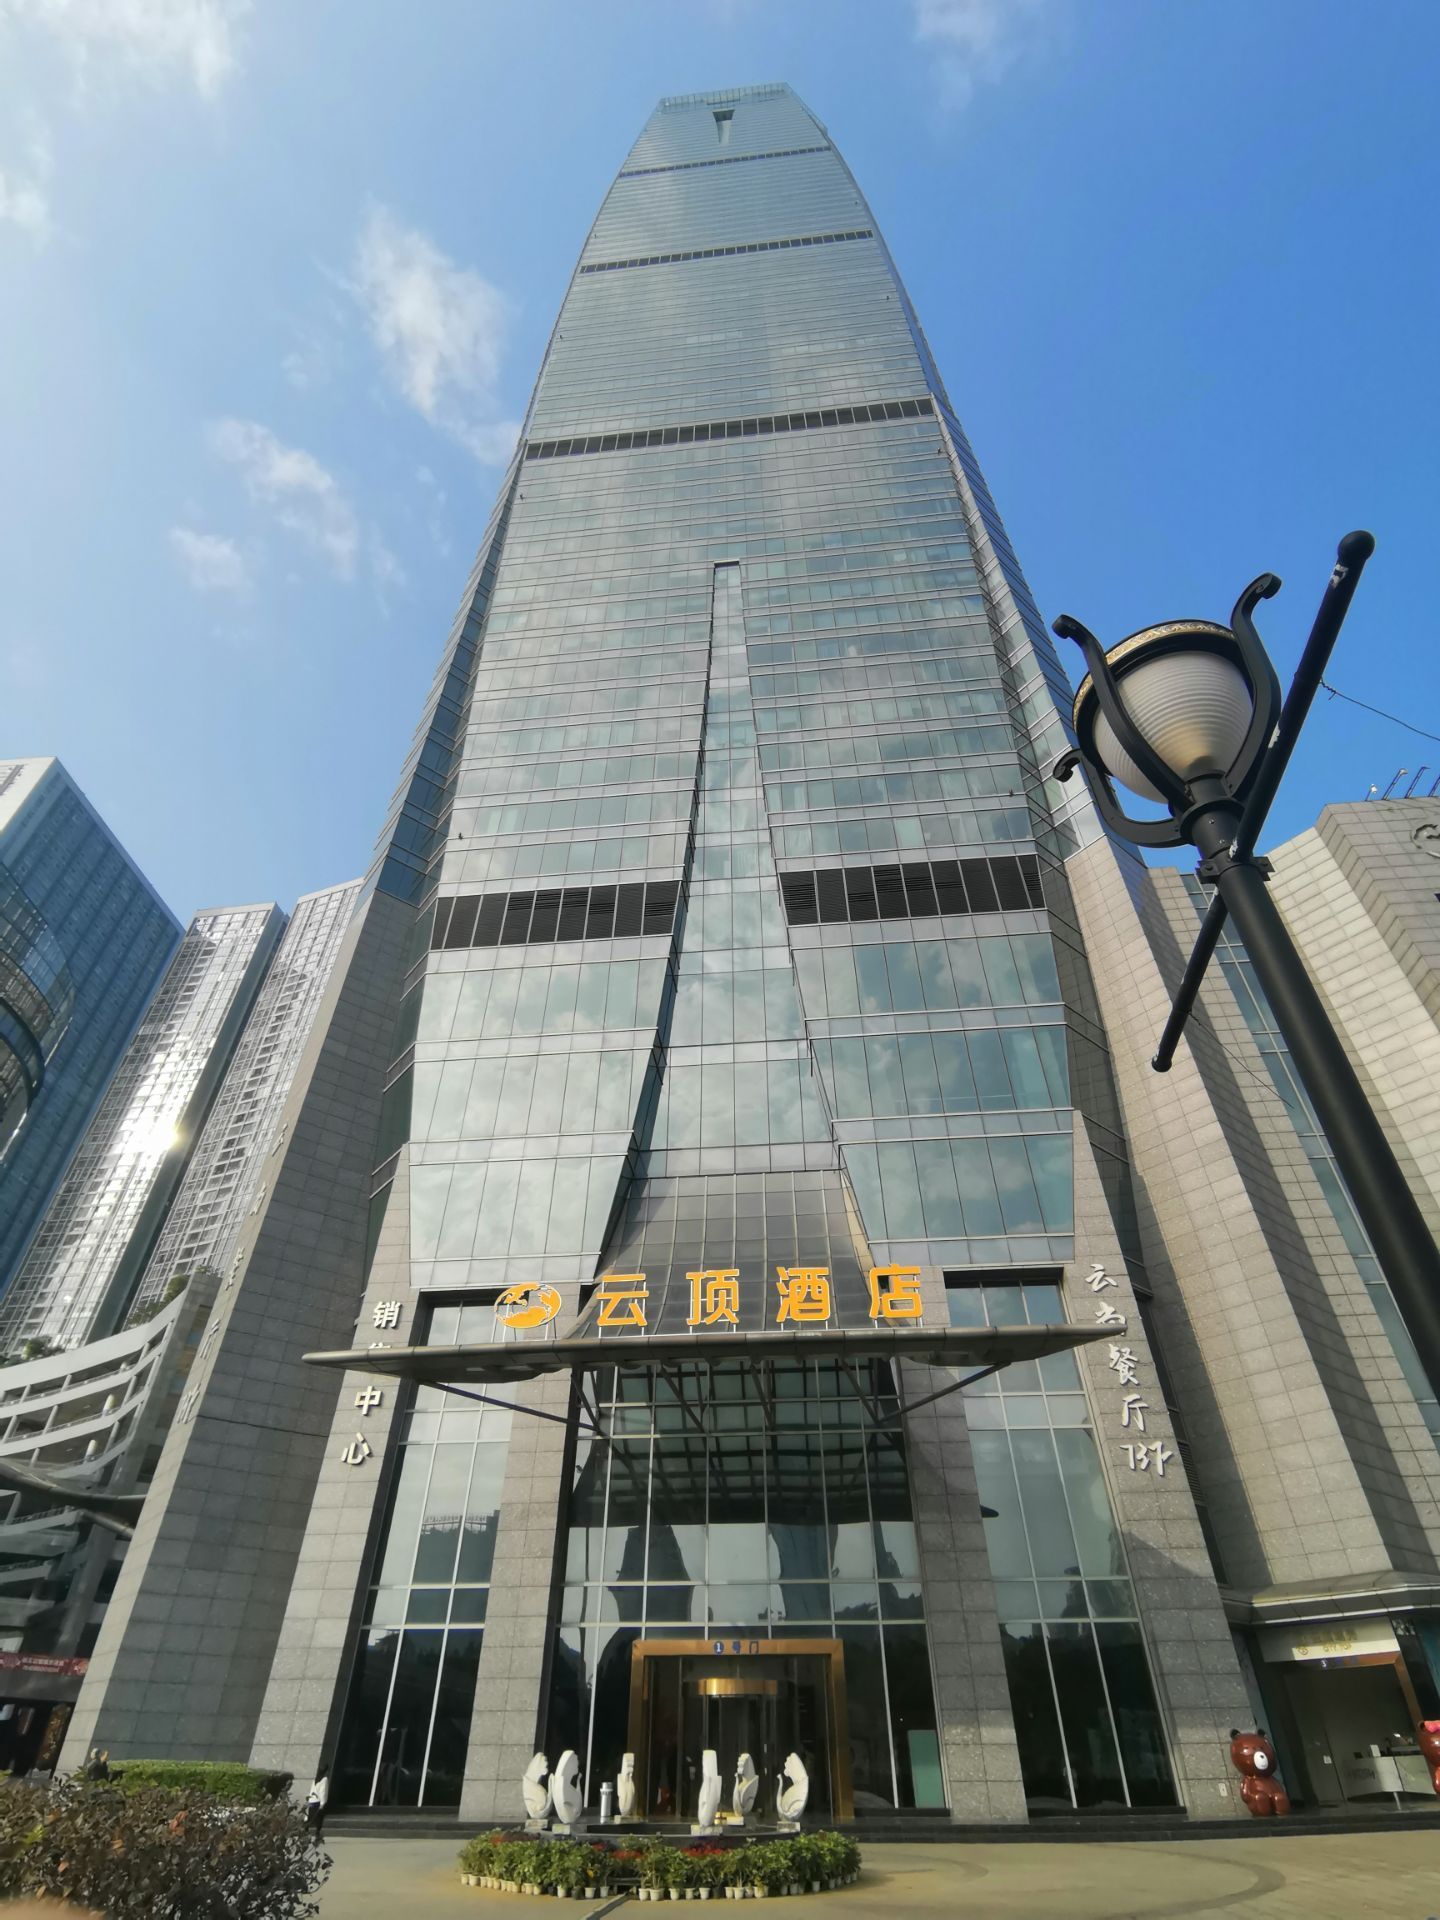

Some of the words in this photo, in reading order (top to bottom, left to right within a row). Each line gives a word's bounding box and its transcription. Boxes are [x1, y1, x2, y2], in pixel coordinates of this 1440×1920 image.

[597, 1264, 923, 1326] 云顶酒店
[341, 1301, 402, 1465] 销中心
